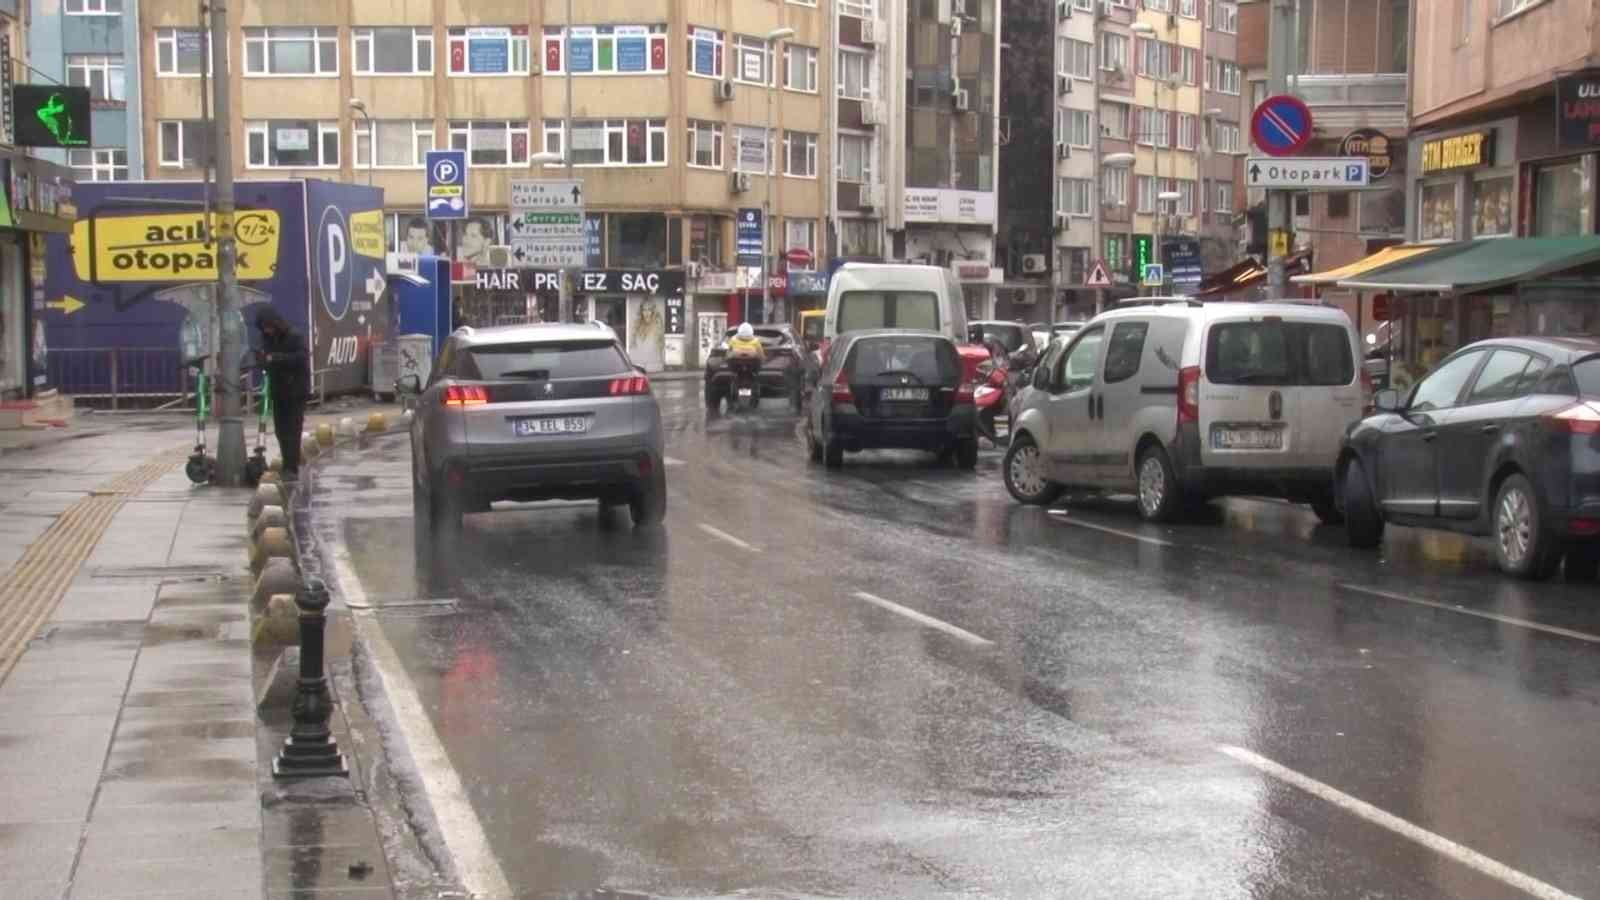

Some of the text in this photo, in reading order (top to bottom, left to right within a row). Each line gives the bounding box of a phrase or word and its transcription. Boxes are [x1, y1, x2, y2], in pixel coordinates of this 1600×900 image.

[440, 164, 453, 180] P
[1268, 166, 1360, 181] Otopark P
[112, 249, 250, 273] otopak
[327, 223, 346, 303] P
[621, 273, 659, 293] SAÇ
[328, 335, 359, 365] AUTO
